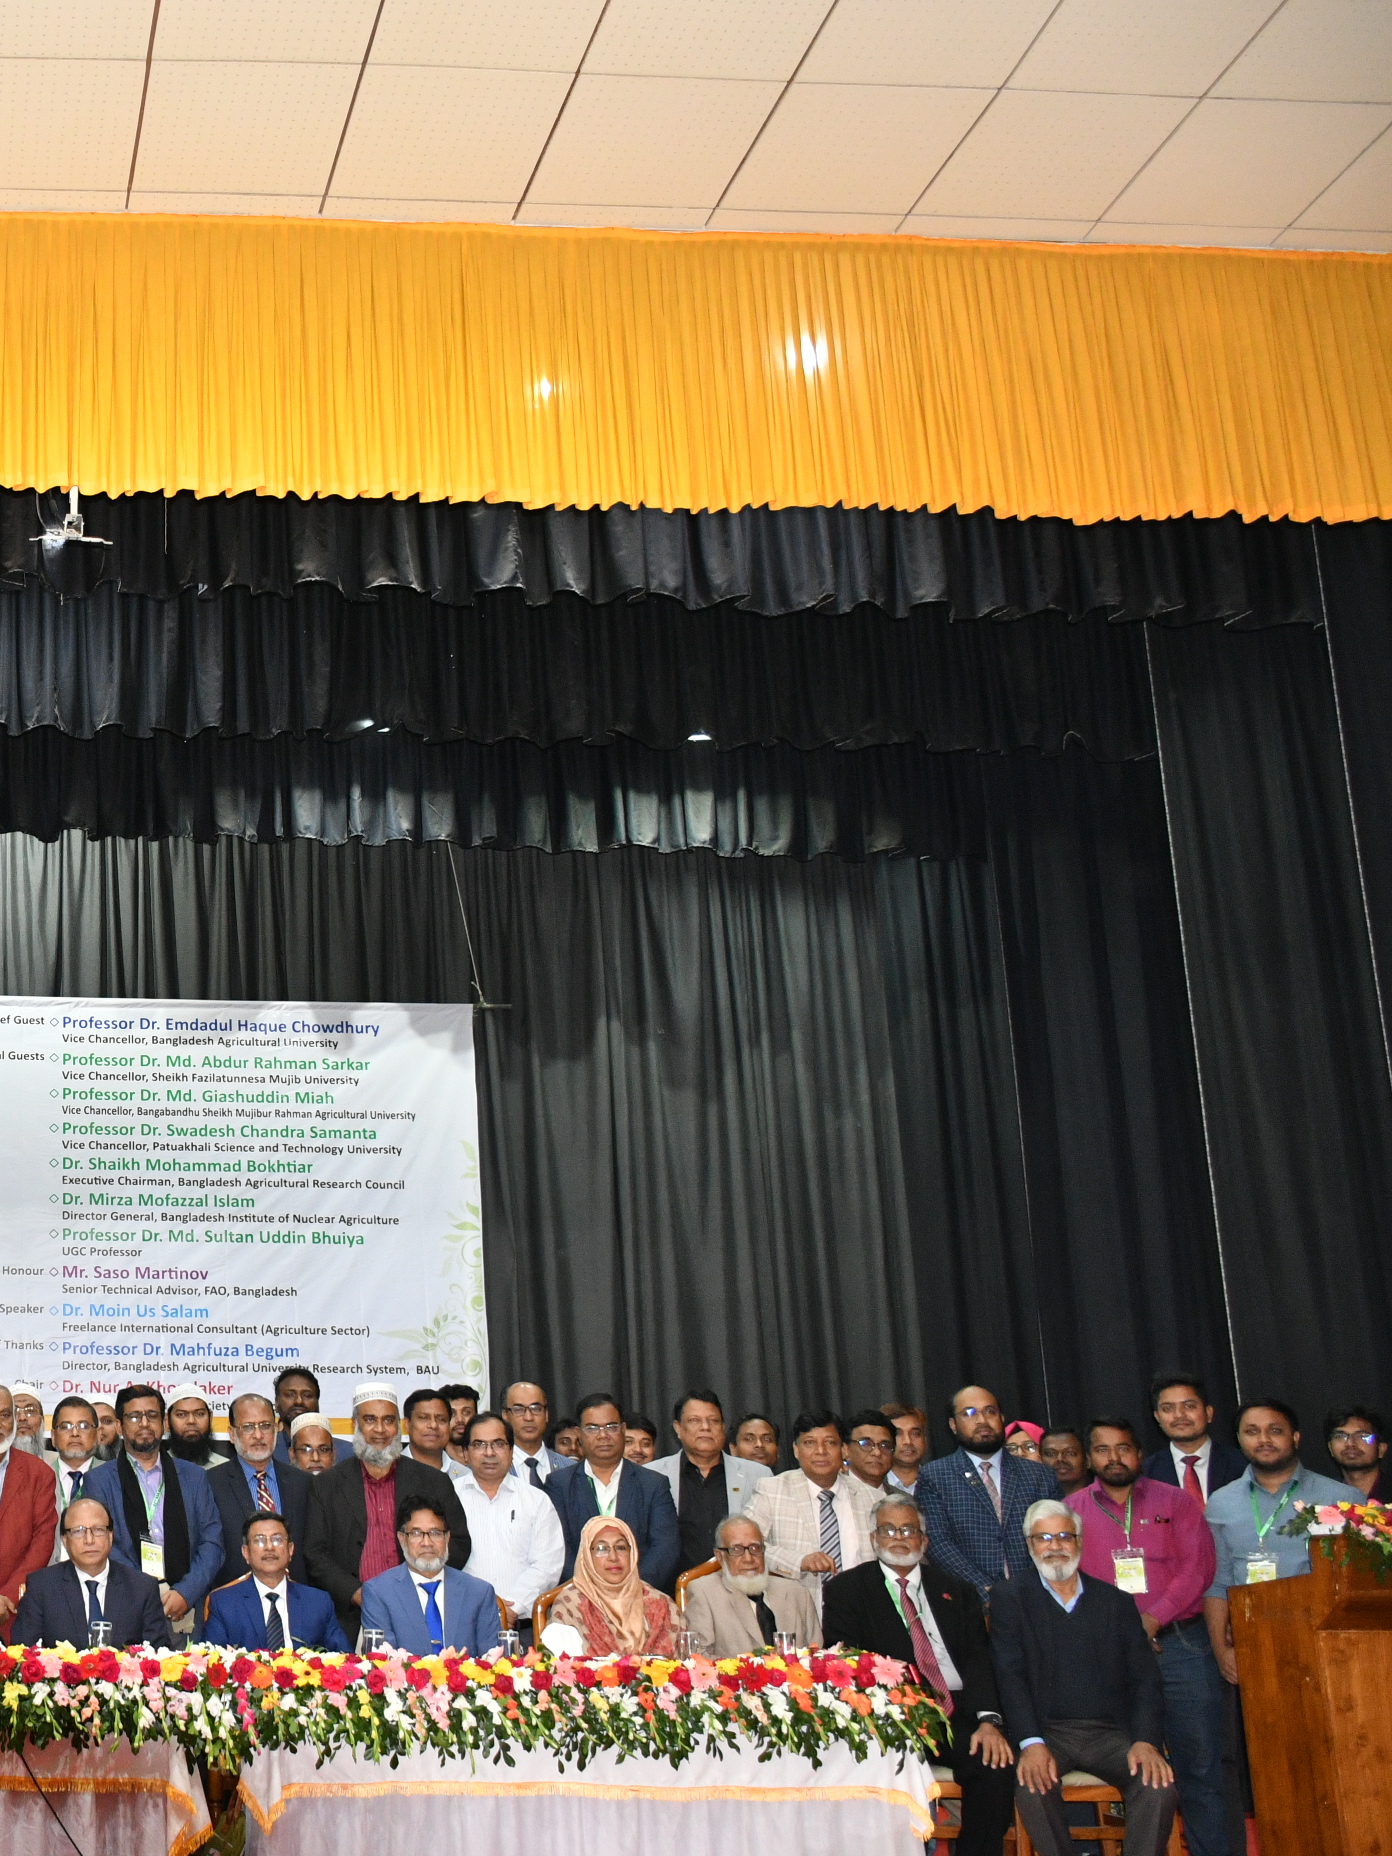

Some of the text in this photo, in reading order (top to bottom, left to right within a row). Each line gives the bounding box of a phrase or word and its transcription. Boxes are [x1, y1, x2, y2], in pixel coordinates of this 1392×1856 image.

[14, 1016, 44, 1025] Guest
[63, 1016, 379, 1037] Professor Dr. Emdadul Haque Chowdhury
[62, 1034, 338, 1050] Vice Chancellor, Bangladesh Agricultural University
[8, 1051, 44, 1060] Guests
[63, 1053, 370, 1070] Professor Dr. Md. Abdur Rahman Sarkar
[62, 1071, 359, 1086] Vice Chancellor, Sheikh Fazilatunnesa Mujib University
[63, 1088, 334, 1104] Professor Dr. Md. Giashuddin Miah
[62, 1106, 415, 1122] Vice Chancellor, Bangabandhu Sheikh Mujibur Rahman Agricultural University
[63, 1122, 376, 1139] Professor Dr. Swadesh Chandra Samanta
[62, 1140, 402, 1156] Vice Chancellor, Patuakhali Science and Technology University
[63, 1157, 313, 1173] Dr. Shaikh Mohammad Bokhtiar
[63, 1176, 404, 1189] Executive Chairman, Bangladesh Agricultural Research Council
[63, 1193, 254, 1207] Dr. Mirza Mofazzal Islam
[63, 1211, 399, 1226] Director General, Bangladesh Institute of Nuclear Agriculture
[63, 1228, 364, 1248] Professor Dr. Md. Sultan Uddin Bhuiya
[63, 1247, 142, 1256] UGC Professor
[2, 1266, 45, 1276] Honour
[63, 1266, 208, 1280] Mr. Saso Martinov
[62, 1284, 297, 1298] Senior Technical Advisor, FAO, Bangladesh
[0, 1304, 44, 1315] Speaker
[63, 1304, 208, 1318] Dr. Moin Us Salam
[63, 1322, 369, 1337] Freelance International Consultant (Agriculture Sector)
[4, 1340, 43, 1350] Thanks
[63, 1341, 299, 1360] Professor Dr. Mahfuza Begum
[63, 1361, 439, 1376] Director, Bangladesh Agricultural Research System, BAU
[63, 1380, 234, 1396] Dr. Nur Khoaker
